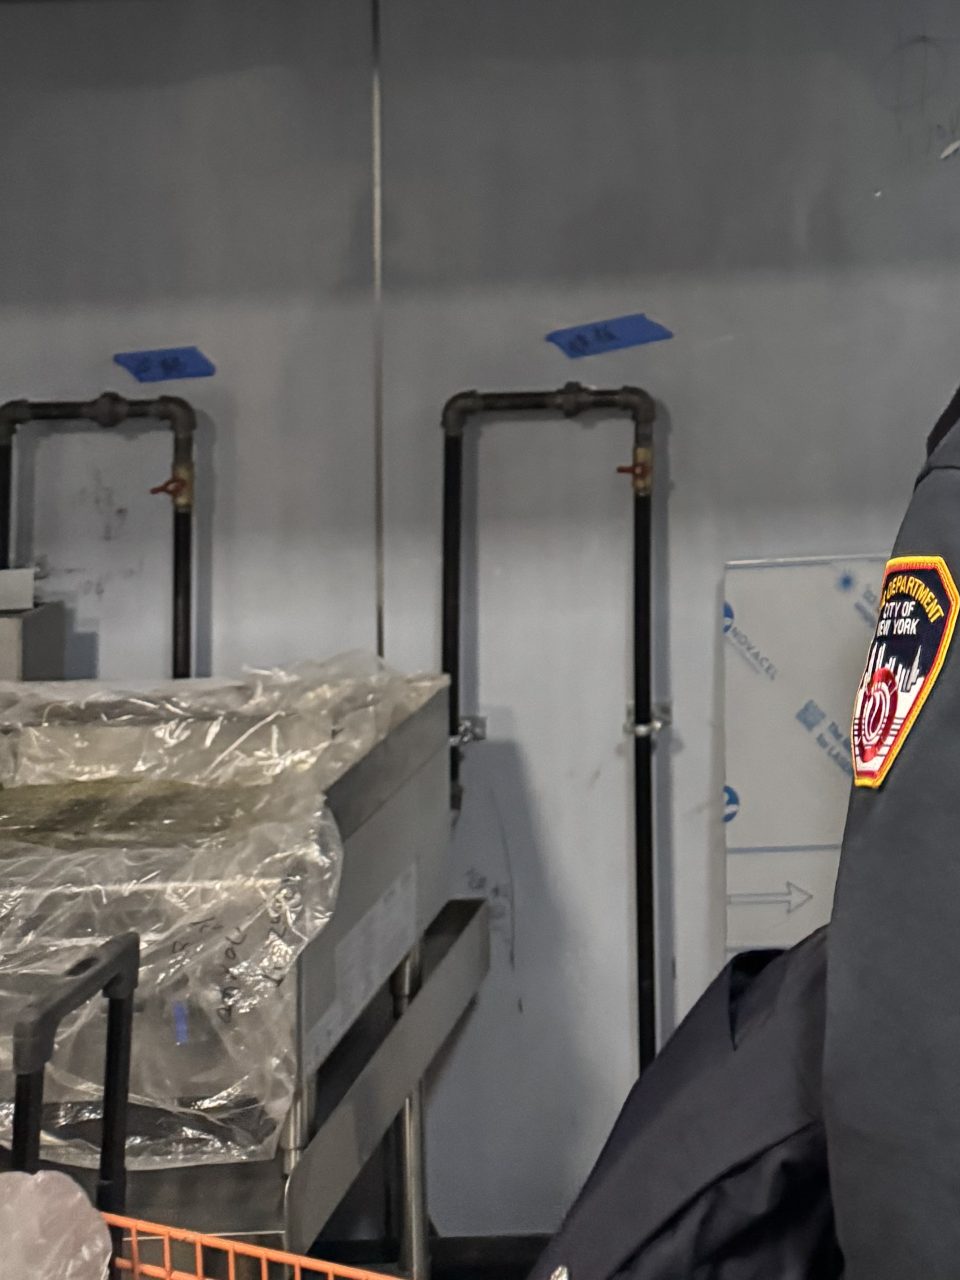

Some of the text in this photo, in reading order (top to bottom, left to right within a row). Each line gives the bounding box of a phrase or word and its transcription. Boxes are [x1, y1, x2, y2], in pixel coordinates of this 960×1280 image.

[887, 575, 944, 623] DEPARTMENT
[901, 601, 916, 618] OF
[893, 618, 920, 636] YORK
